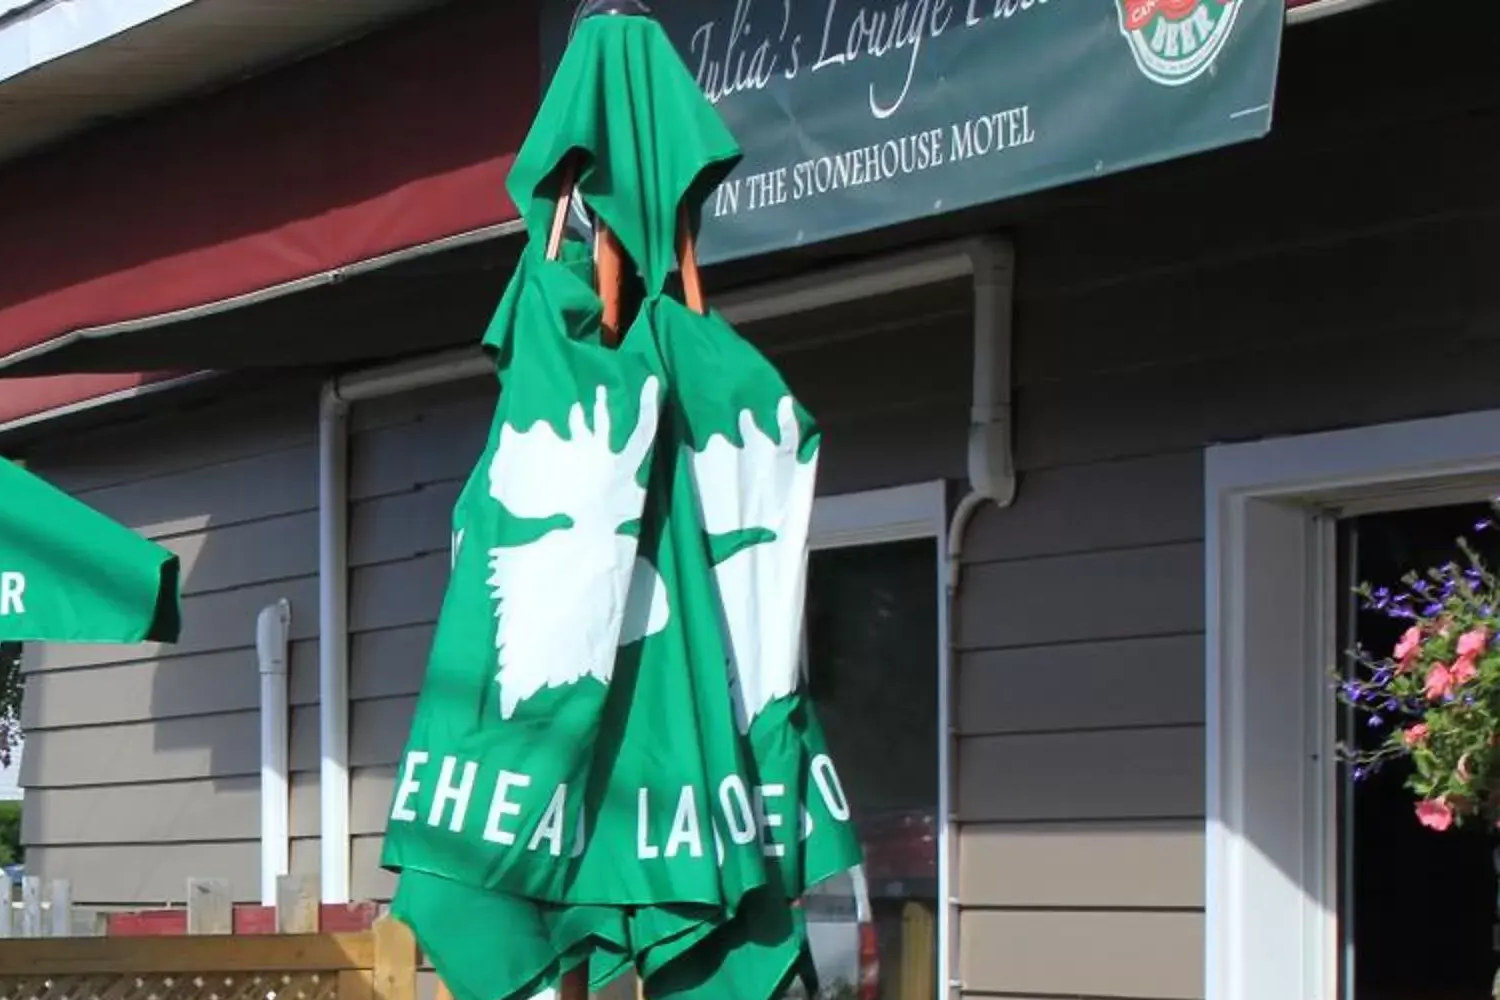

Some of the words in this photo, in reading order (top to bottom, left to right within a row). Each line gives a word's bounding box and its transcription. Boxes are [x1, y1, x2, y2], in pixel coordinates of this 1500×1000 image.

[691, 0, 801, 104] Julia's
[812, 0, 953, 119] Lounge
[714, 180, 742, 217] IN
[745, 167, 787, 210] THE
[793, 128, 944, 200] STONEHOUSE
[950, 106, 1036, 162] MOTEL
